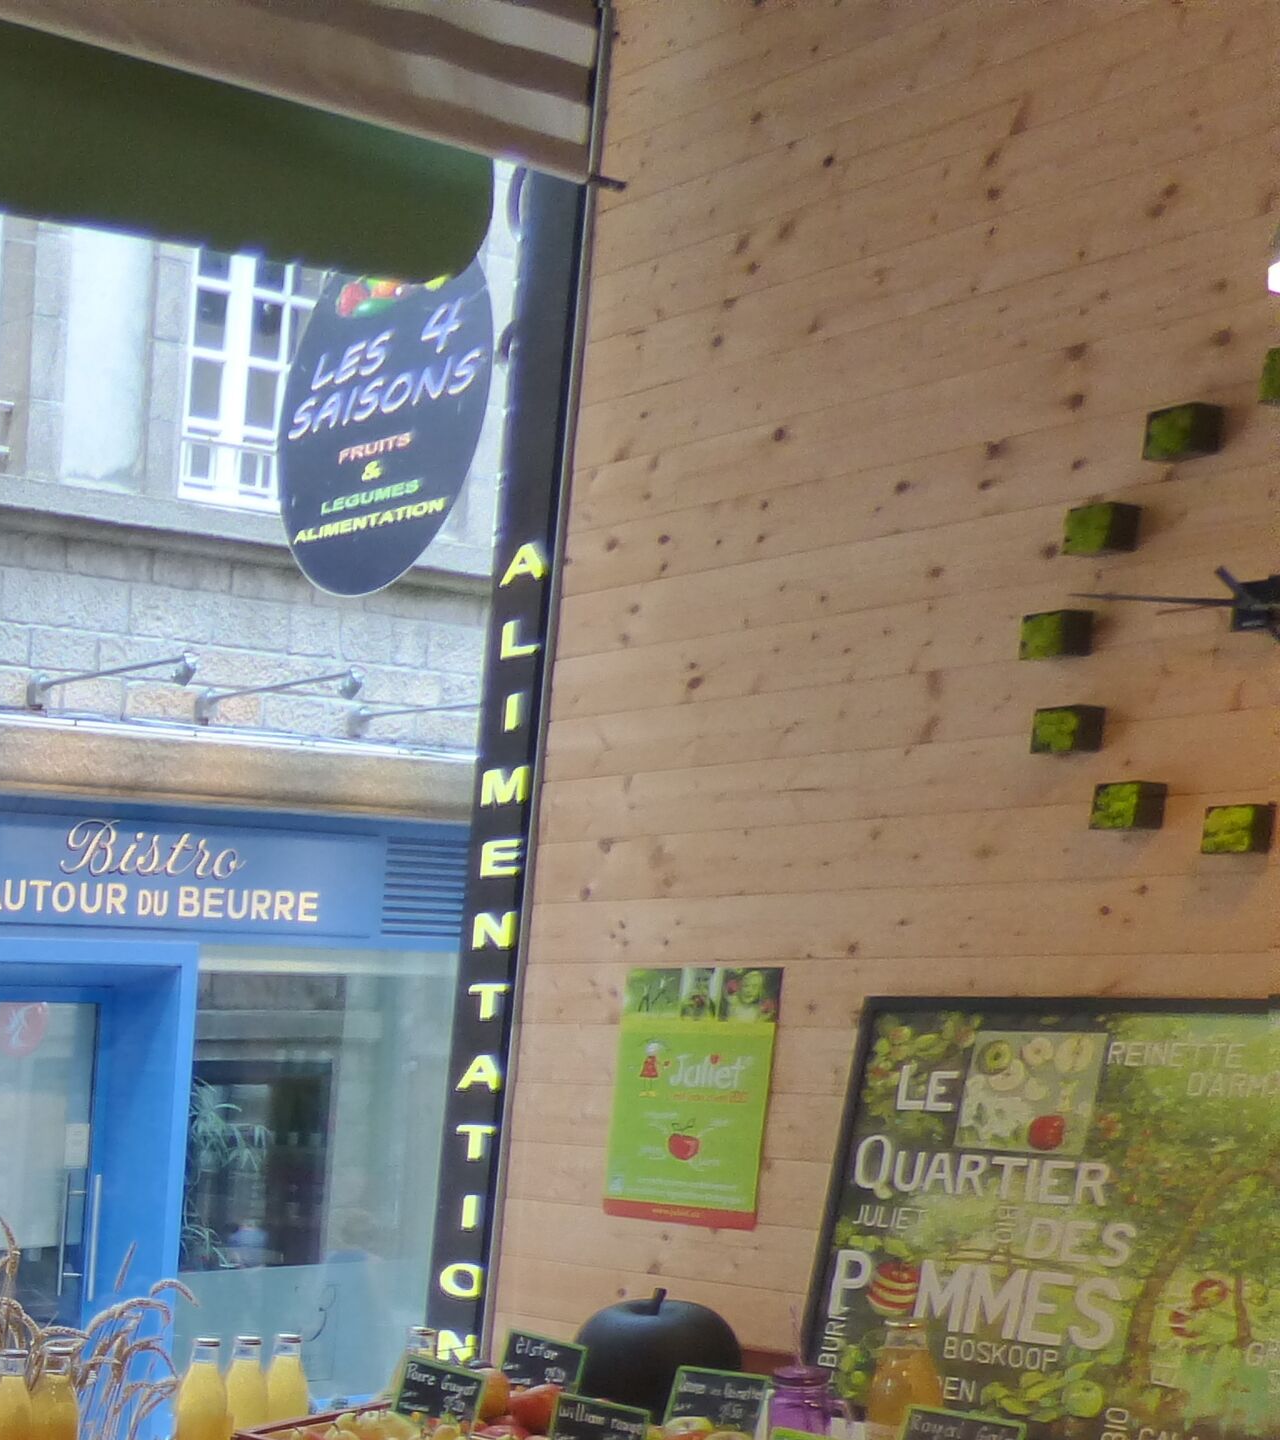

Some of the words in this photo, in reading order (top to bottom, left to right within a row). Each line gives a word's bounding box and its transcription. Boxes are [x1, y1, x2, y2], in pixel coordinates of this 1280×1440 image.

[311, 329, 396, 391] LES
[420, 298, 465, 354] 4
[288, 347, 487, 440] SAISONS
[338, 431, 414, 465] FRUITS
[293, 496, 448, 545] ALIMENTATION
[59, 818, 247, 879] Bistro
[137, 889, 170, 918] DU
[177, 886, 320, 923] BEURRE
[437, 540, 548, 1363] ALIMENTATION
[894, 1062, 960, 1112] LE
[853, 1134, 1110, 1207] QUARTIER
[852, 1204, 929, 1230] JULIET
[1022, 1217, 1137, 1269] DES
[942, 1337, 1060, 1372] BOSKOOP
